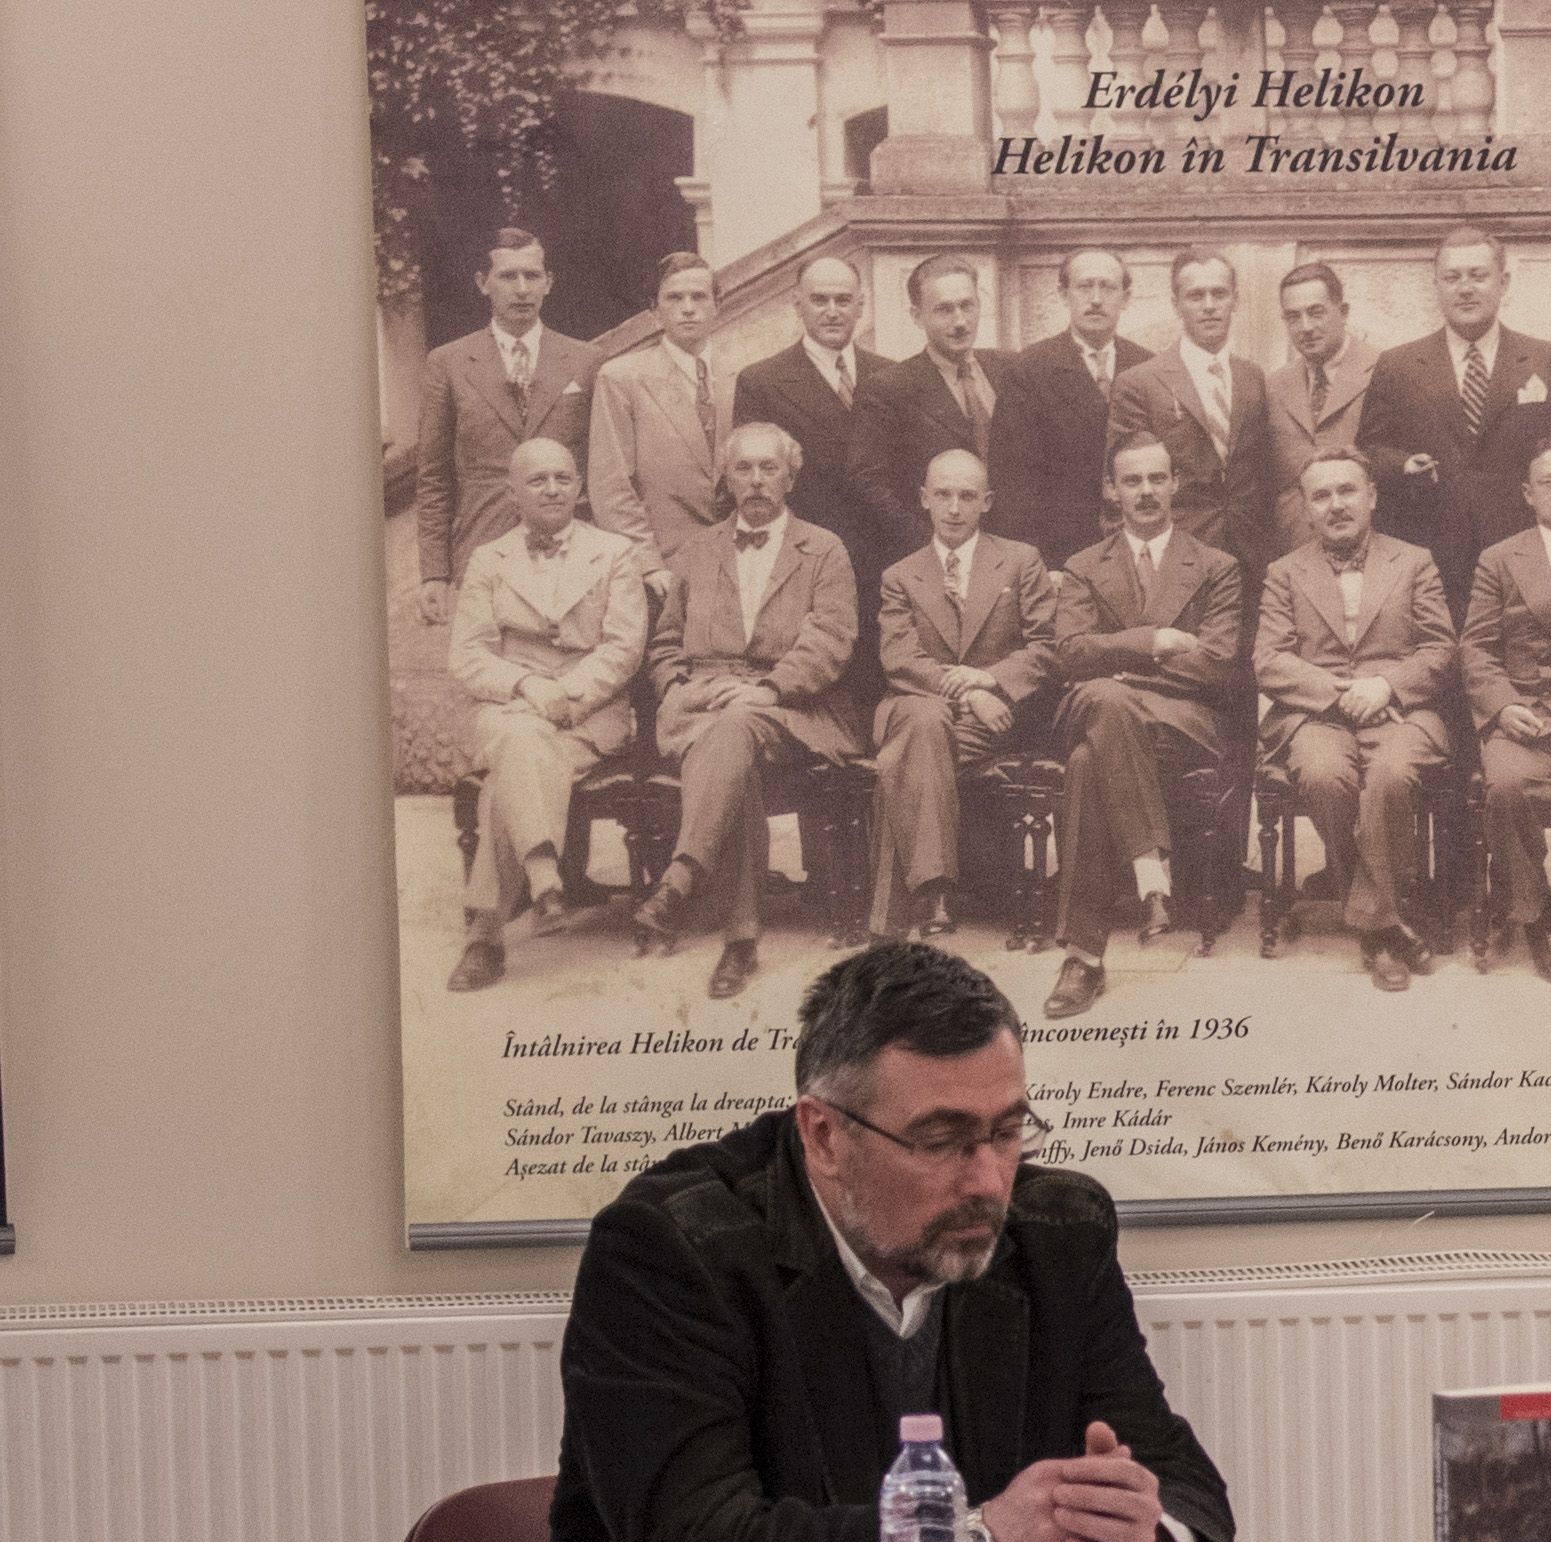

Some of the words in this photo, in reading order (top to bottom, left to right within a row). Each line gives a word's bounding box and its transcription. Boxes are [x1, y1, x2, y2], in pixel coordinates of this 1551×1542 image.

[1082, 69, 1239, 122] Erdélyi
[1252, 70, 1425, 109] Helikon
[991, 136, 1165, 175] Helikon
[1182, 137, 1224, 174] în
[1245, 132, 1517, 173] Transilvania
[503, 1030, 622, 1058] Întâlnirea
[630, 1030, 723, 1054] Helikon
[731, 1028, 759, 1051] de
[1022, 1021, 1148, 1048] âncovenești
[1156, 1019, 1179, 1040] în
[1190, 1016, 1250, 1040] 1936
[504, 1097, 564, 1117] Stând,
[572, 1096, 594, 1115] de
[599, 1095, 617, 1114] la
[623, 1095, 684, 1118] stânga
[690, 1092, 707, 1112] la
[713, 1092, 792, 1116] dreapta:
[1088, 1080, 1147, 1099] Endre,
[1156, 1080, 1216, 1097] Ferenc
[1222, 1076, 1298, 1096] Szemlér,
[1373, 1073, 1439, 1092] Molter,
[1446, 1070, 1513, 1090] Sándor
[508, 1127, 574, 1146] Sándor
[581, 1125, 657, 1148] Tavaszy,
[664, 1121, 724, 1141] Albert
[1062, 1111, 1106, 1129] Imre
[1112, 1108, 1173, 1128] Kádár
[505, 1157, 566, 1180] Așezat
[572, 1155, 594, 1173] de
[600, 1155, 617, 1172] la
[1080, 1139, 1123, 1162] Jenő
[1129, 1136, 1188, 1156] Dsida,
[1193, 1132, 1245, 1158] János
[1251, 1134, 1328, 1154] Kemény,
[1336, 1132, 1384, 1150] Benő
[1389, 1130, 1487, 1152] Karácsony,
